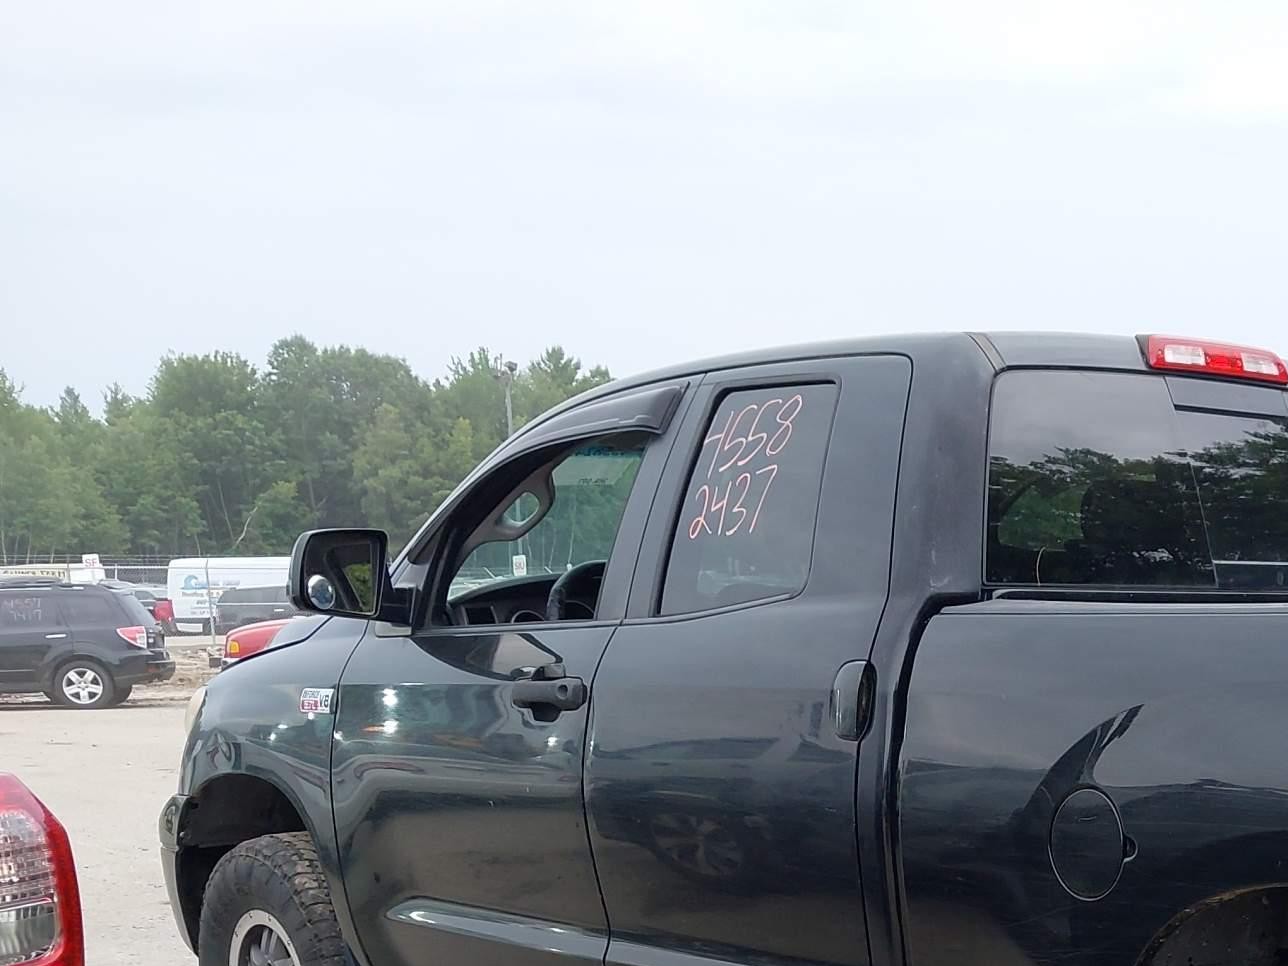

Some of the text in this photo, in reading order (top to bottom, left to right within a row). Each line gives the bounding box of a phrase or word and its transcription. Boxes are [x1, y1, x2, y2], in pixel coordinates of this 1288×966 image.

[704, 394, 802, 479] 4558
[689, 464, 778, 539] 2437
[84, 558, 99, 568] SF
